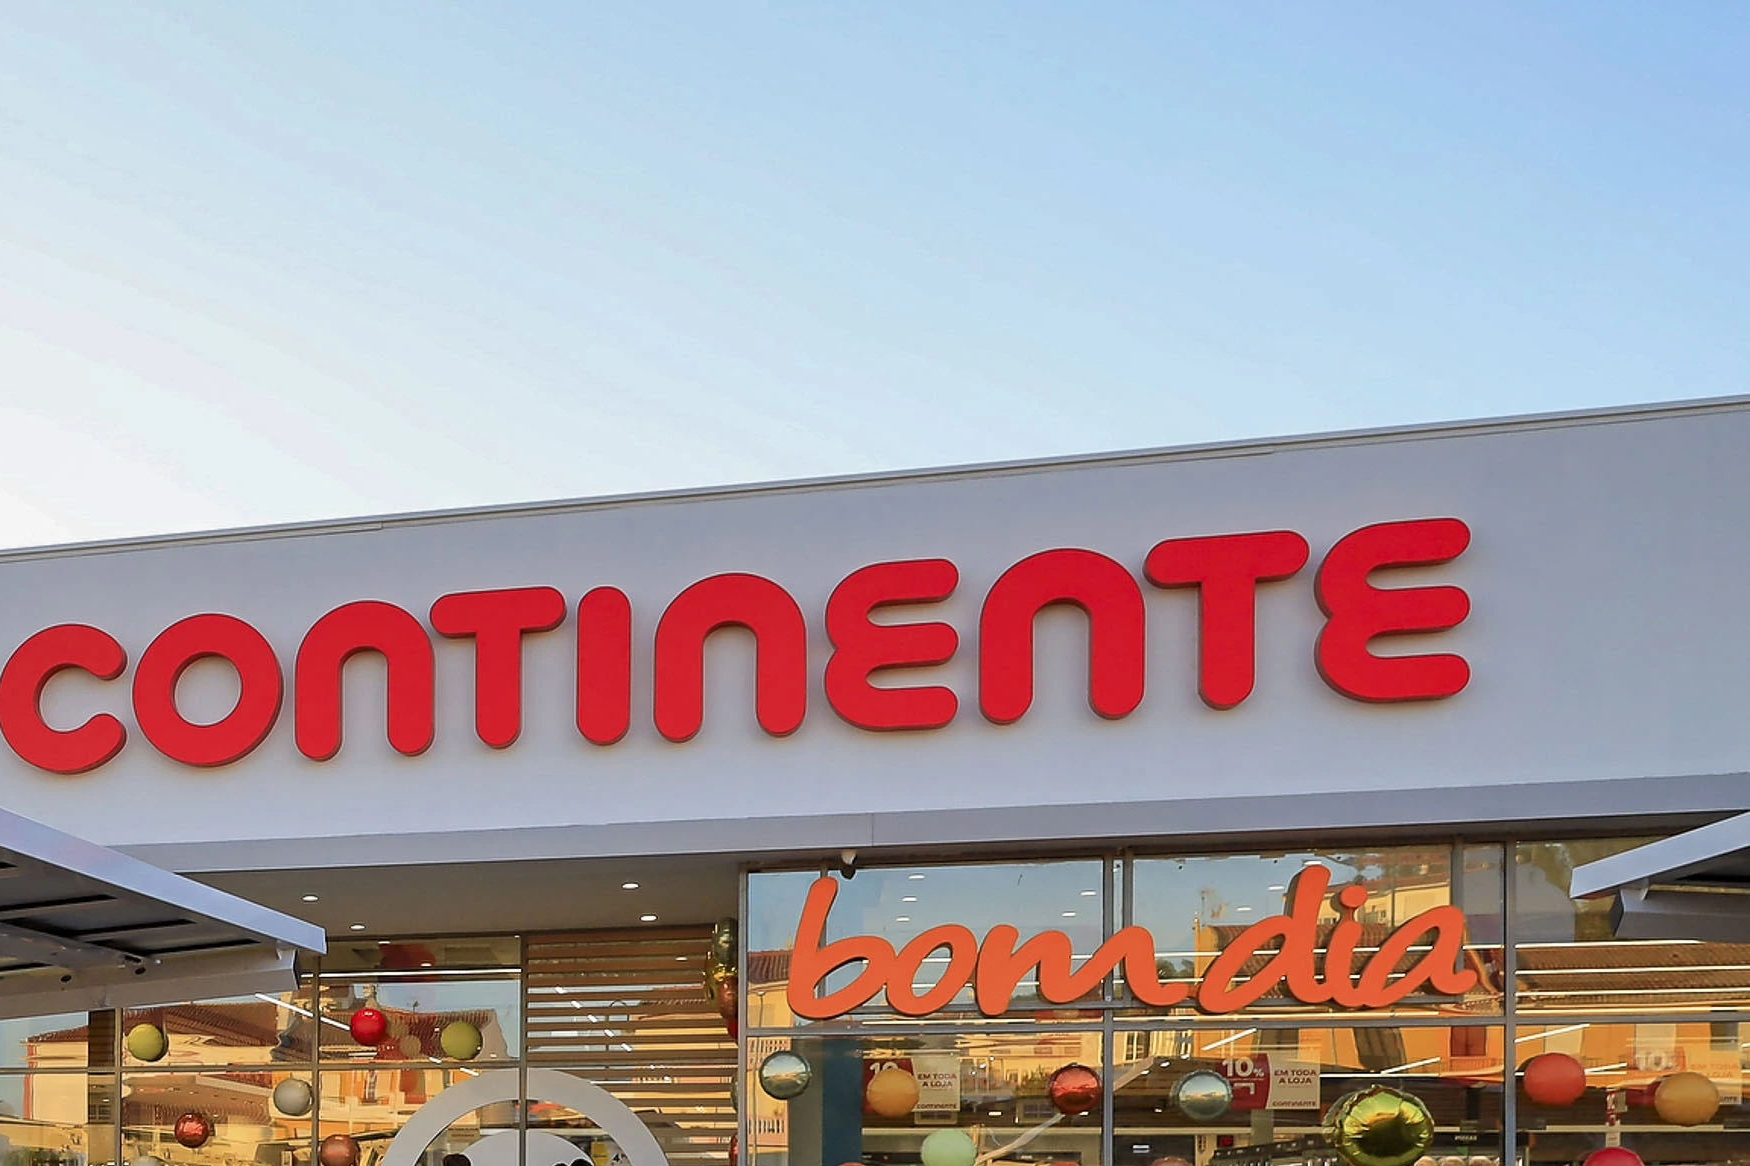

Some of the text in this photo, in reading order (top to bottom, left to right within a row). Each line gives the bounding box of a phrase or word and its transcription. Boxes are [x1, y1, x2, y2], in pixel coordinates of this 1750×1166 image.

[787, 863, 1479, 1020] bom dia
[917, 1073, 958, 1081] EM TODA
[1287, 1077, 1313, 1085] LOJA
